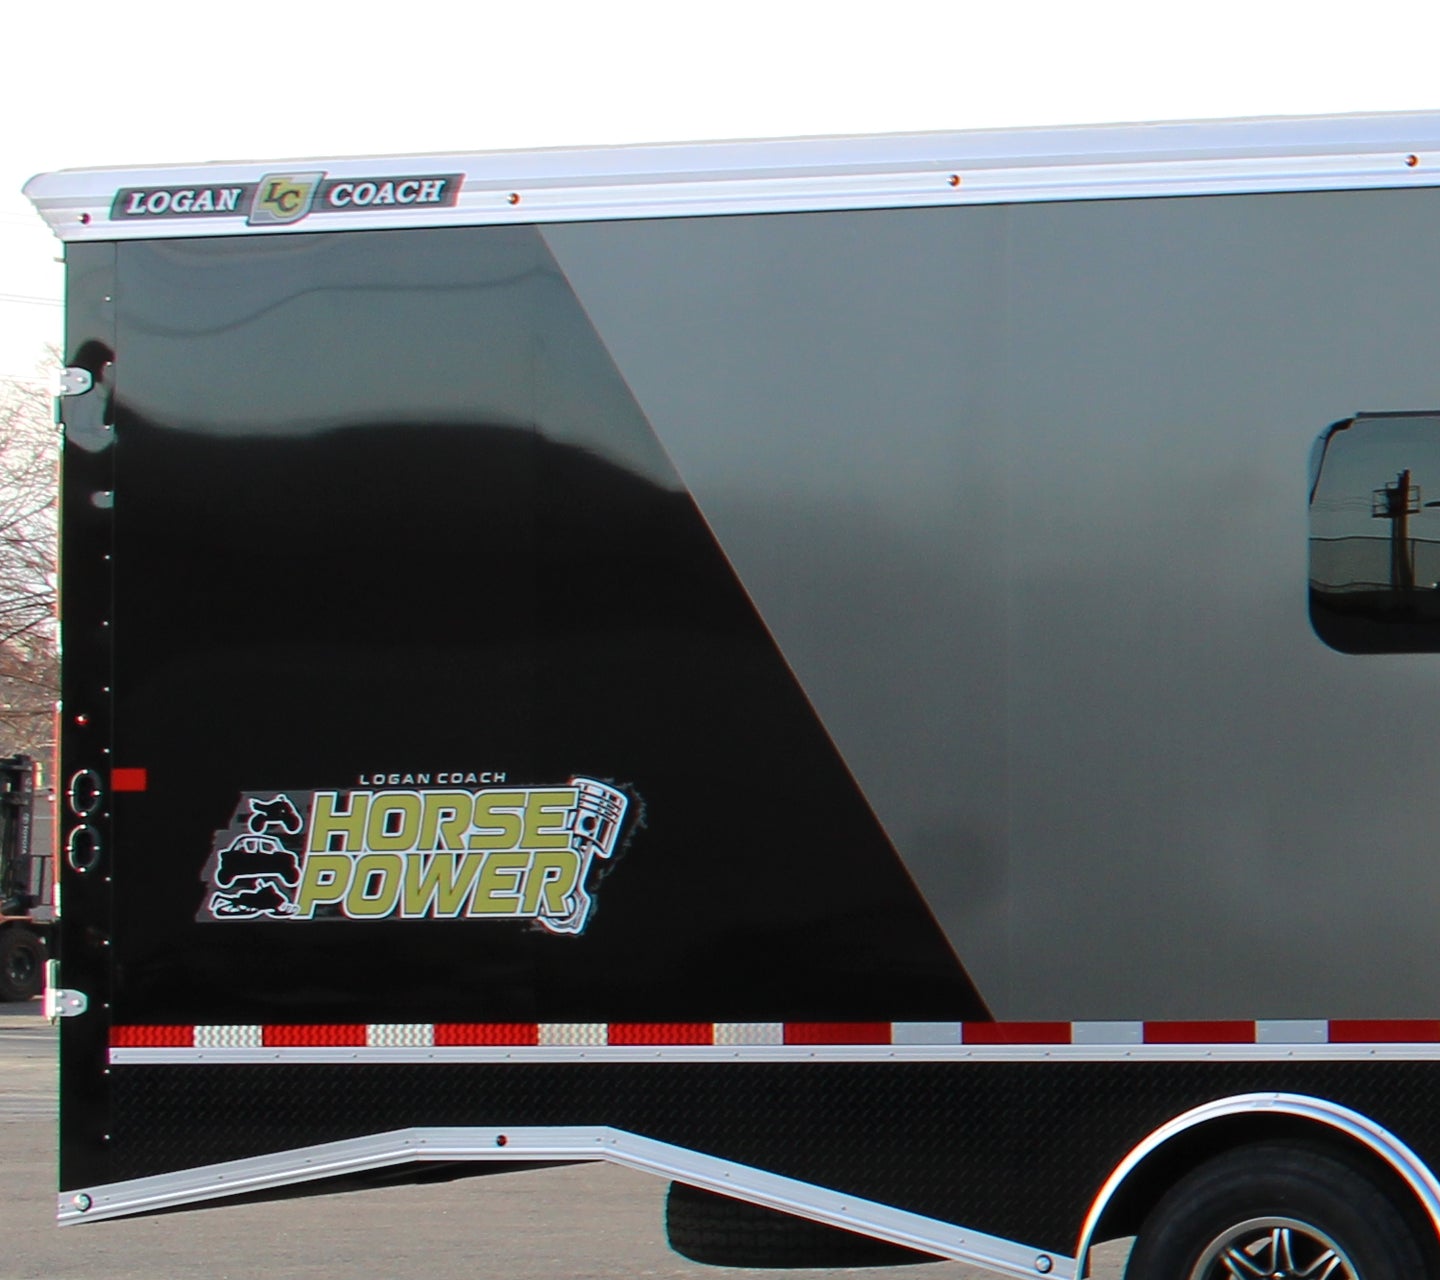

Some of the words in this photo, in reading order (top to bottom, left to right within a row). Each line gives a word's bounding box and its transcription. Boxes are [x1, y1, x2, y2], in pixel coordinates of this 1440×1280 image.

[126, 188, 242, 215] LOGAN
[263, 182, 302, 215] LC
[329, 179, 446, 207] COACH
[359, 773, 430, 786] LOGAN
[437, 772, 507, 784] COACH
[310, 789, 580, 853] HORSE
[297, 850, 581, 920] POWER
